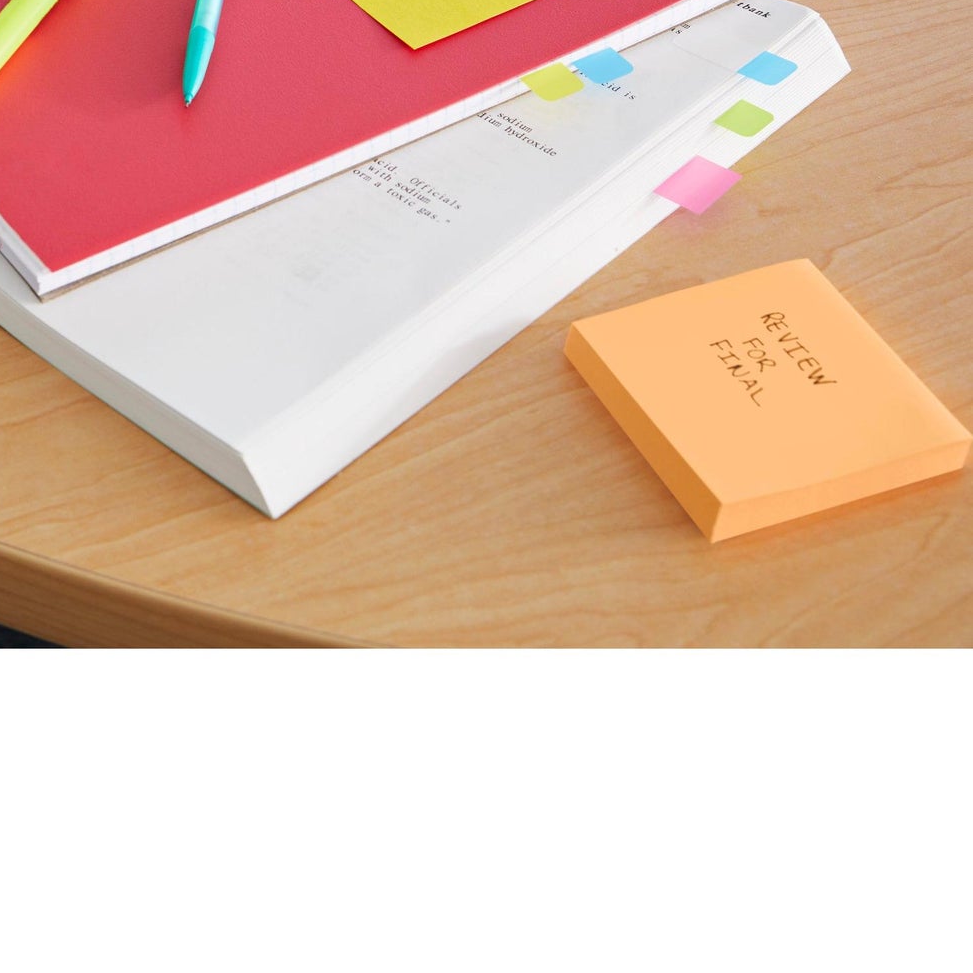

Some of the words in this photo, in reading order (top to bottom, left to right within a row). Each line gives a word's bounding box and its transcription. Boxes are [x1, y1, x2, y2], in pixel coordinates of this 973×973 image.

[623, 90, 636, 101] is
[496, 111, 533, 133] sodium
[504, 125, 558, 158] hydroxide
[368, 164, 392, 182] with
[395, 180, 432, 205] sodium
[373, 180, 382, 189] a
[386, 187, 416, 208] toxic
[409, 176, 463, 211] Officials
[742, 337, 777, 373] FOR
[760, 311, 838, 385] REVIEW
[709, 338, 764, 408] FINAL
